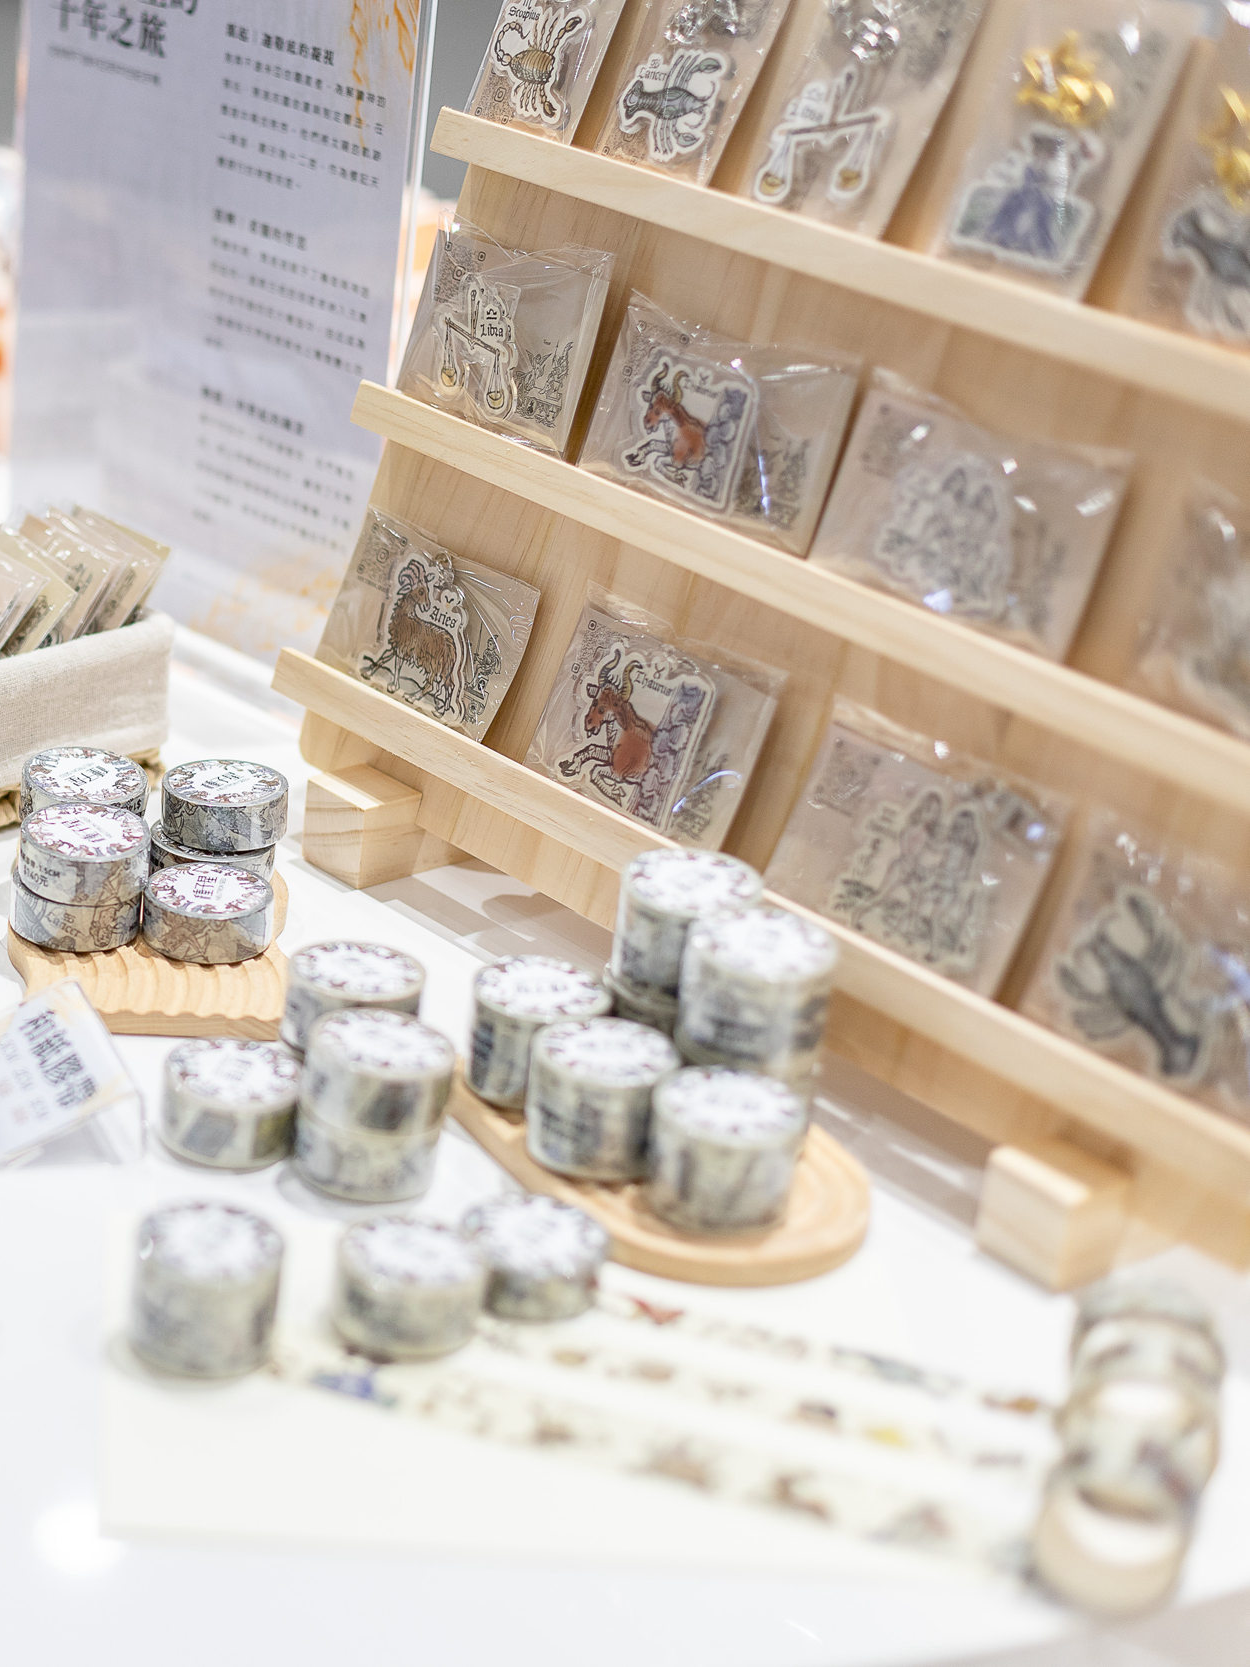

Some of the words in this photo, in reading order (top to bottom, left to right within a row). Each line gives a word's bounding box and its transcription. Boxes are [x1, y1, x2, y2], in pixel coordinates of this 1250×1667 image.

[508, 6, 540, 21] Scorpius
[50, 0, 167, 58] 十年之旅
[637, 66, 667, 82] Cancer
[479, 323, 504, 338] Libra
[429, 605, 459, 629] Aries
[45, 911, 83, 937] Cancer
